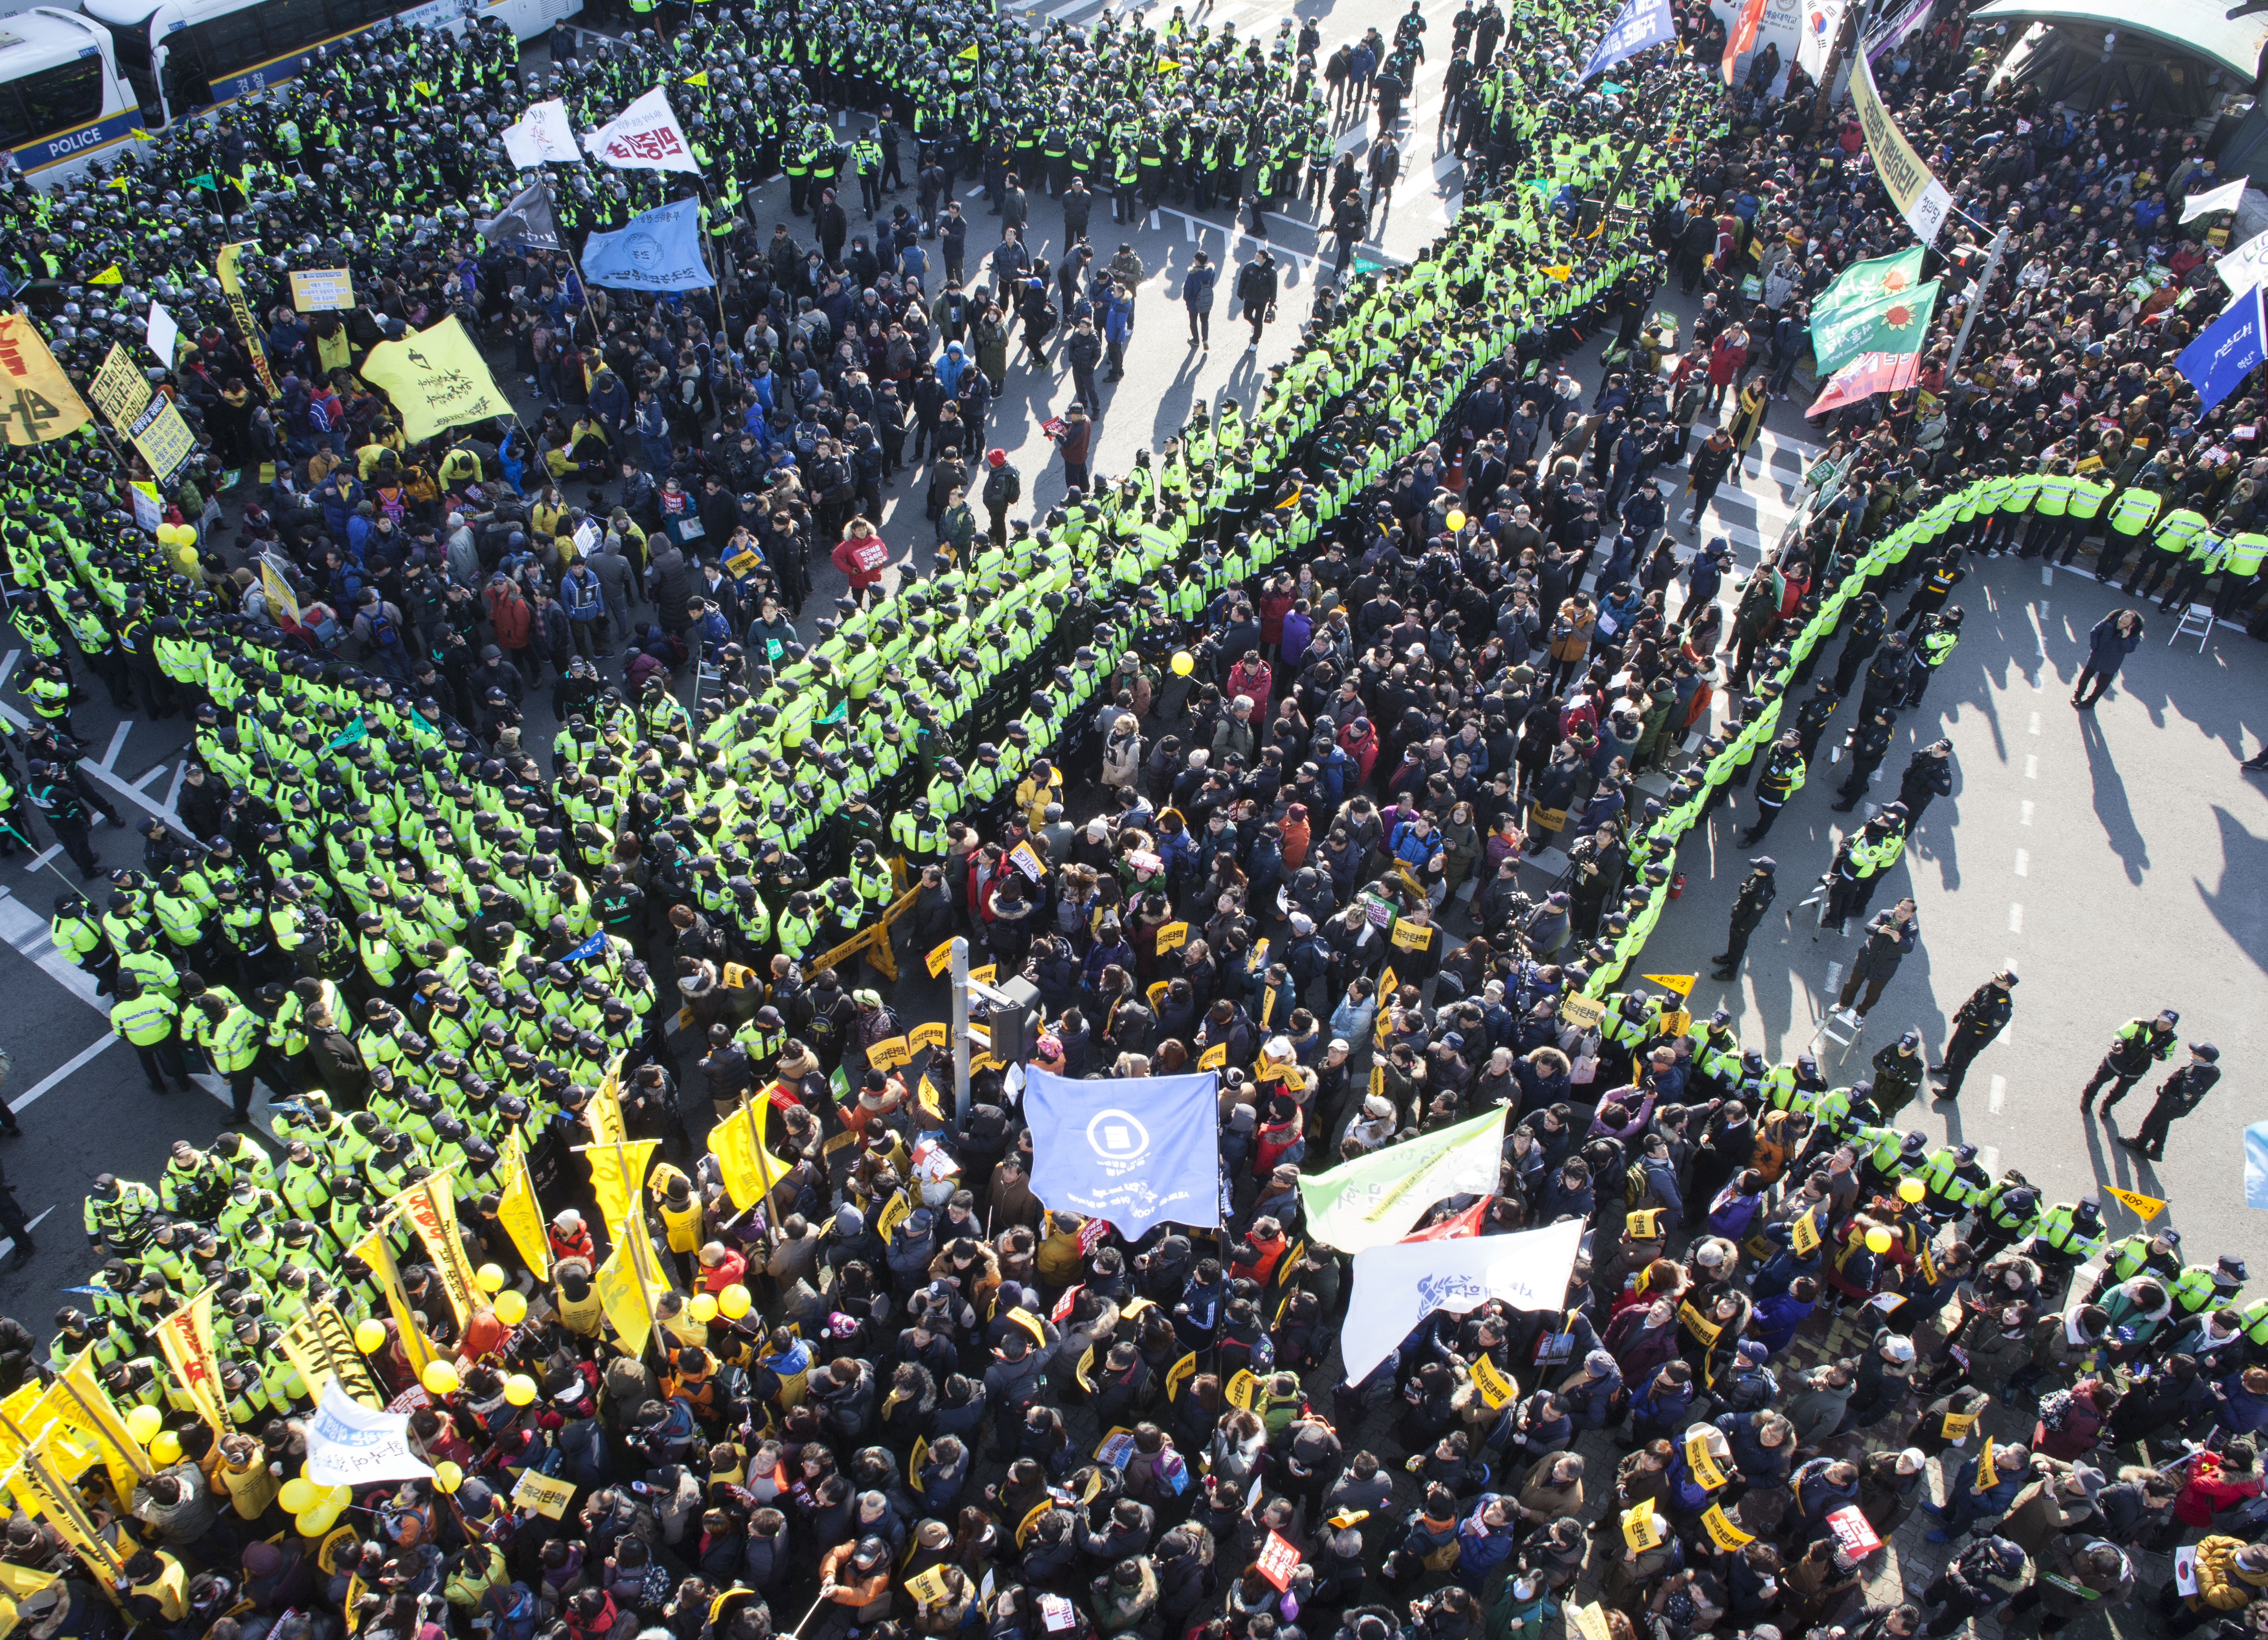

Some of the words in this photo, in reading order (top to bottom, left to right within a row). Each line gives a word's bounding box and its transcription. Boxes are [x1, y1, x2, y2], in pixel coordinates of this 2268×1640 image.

[237, 72, 267, 94] 경찰
[49, 127, 102, 157] POLICE
[1879, 131, 1919, 202] 개방하라!
[1921, 195, 1941, 224] 정의당
[102, 272, 117, 282] 21-1
[93, 370, 119, 403] 세월호의
[110, 348, 129, 375] 진실
[104, 383, 131, 421] 살아있는
[142, 426, 158, 445] 투표로
[153, 445, 170, 464] 세월호
[1321, 446, 1336, 456] POLICE
[2046, 483, 2069, 492] POLICE
[2080, 490, 2100, 501] POLICE
[2130, 499, 2151, 509] POLICE
[2181, 520, 2200, 530] POLICE
[860, 544, 881, 557] 박근혜를
[2240, 543, 2264, 551] POLICE
[731, 555, 757, 572] 즉각탄핵
[863, 551, 884, 564] 구속하라
[1933, 574, 1951, 586] POLICE
[1003, 697, 1018, 709] POLICE
[828, 705, 845, 724] 229-1
[343, 724, 362, 741] 35-2
[981, 719, 996, 732] POLICE
[899, 789, 915, 803] POLICE
[604, 903, 629, 912] POLICE
[1158, 930, 1184, 946] 즉각탄핵
[1395, 928, 1428, 943] 즉각탄핵
[835, 945, 853, 958] LINE
[929, 946, 952, 969] 즉각탄
[125, 1008, 159, 1022] POLICE
[1565, 1000, 1598, 1021] 즉각탄핵
[910, 1030, 943, 1046] 즉각탄핵
[872, 1046, 905, 1066] 즉각탄핵
[1681, 1308, 1714, 1344] 즉각탄핵
[1475, 1363, 1506, 1402] 즉각탄핵
[1692, 1441, 1716, 1485] 즉각탄핵
[523, 1483, 567, 1509] 즉각탄핵
[1631, 1505, 1649, 1547] 즉각탄핵
[1709, 1512, 1744, 1547] 즉각탄핵
